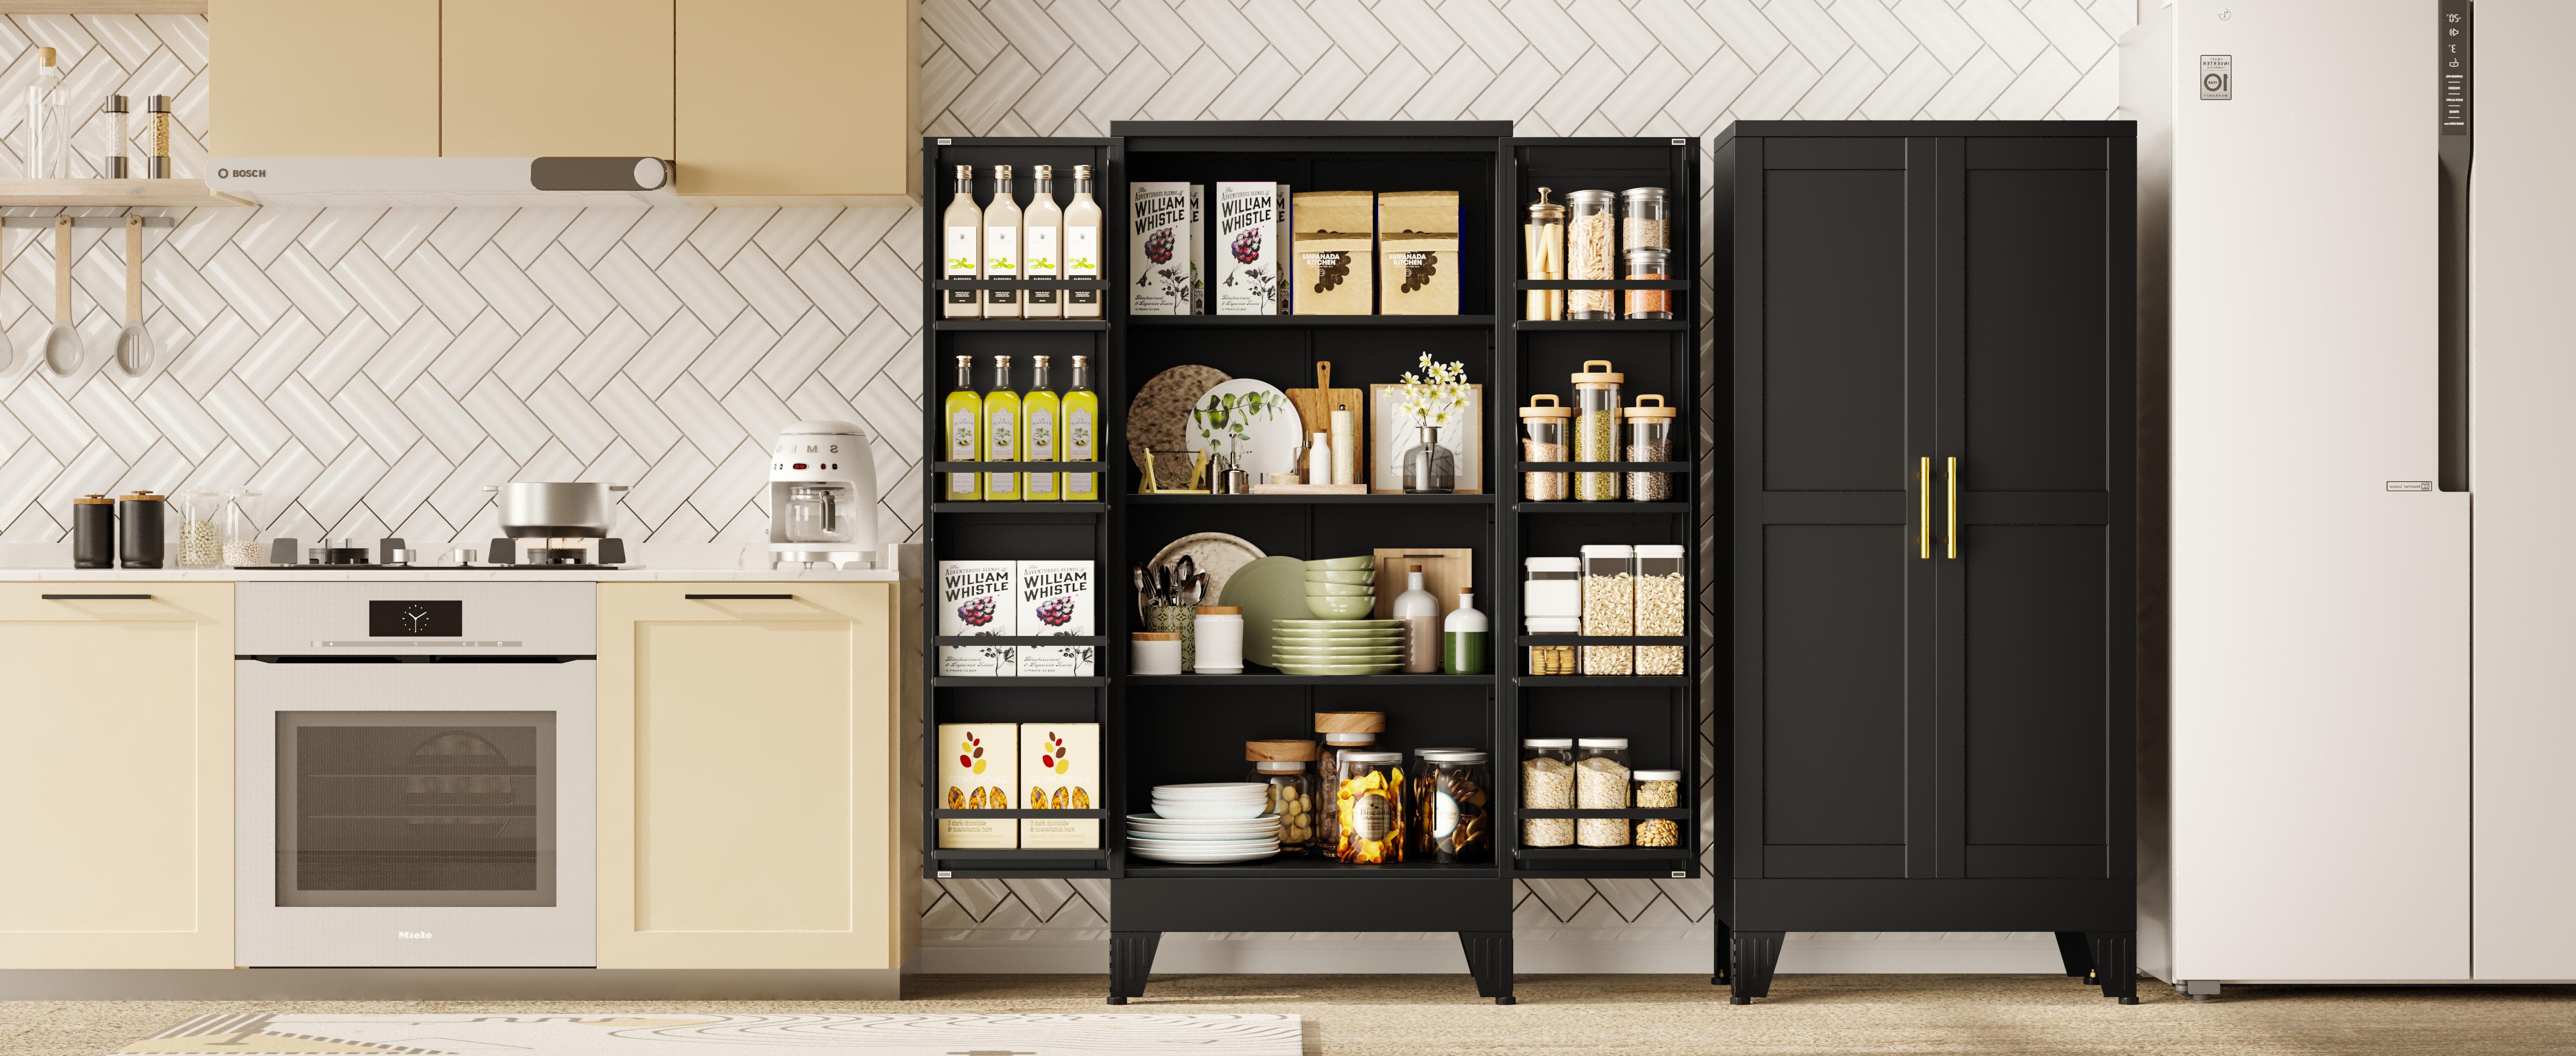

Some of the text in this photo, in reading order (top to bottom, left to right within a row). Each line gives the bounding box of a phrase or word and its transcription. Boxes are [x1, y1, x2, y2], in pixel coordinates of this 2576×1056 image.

[1135, 191, 1163, 202] ADVENTUROUS
[1222, 191, 1250, 201] ADVENTUROUS
[1135, 196, 1184, 218] WILLIAM
[1222, 196, 1271, 218] WILLIAM
[1135, 209, 1184, 236] WHISTLE
[1222, 210, 1271, 236] WHISTLE
[945, 572, 1008, 589] WILLIAM
[1024, 572, 1087, 589] WILLIAM
[945, 582, 1008, 602] WHISTLE
[1024, 582, 1087, 602] WHISTLE
